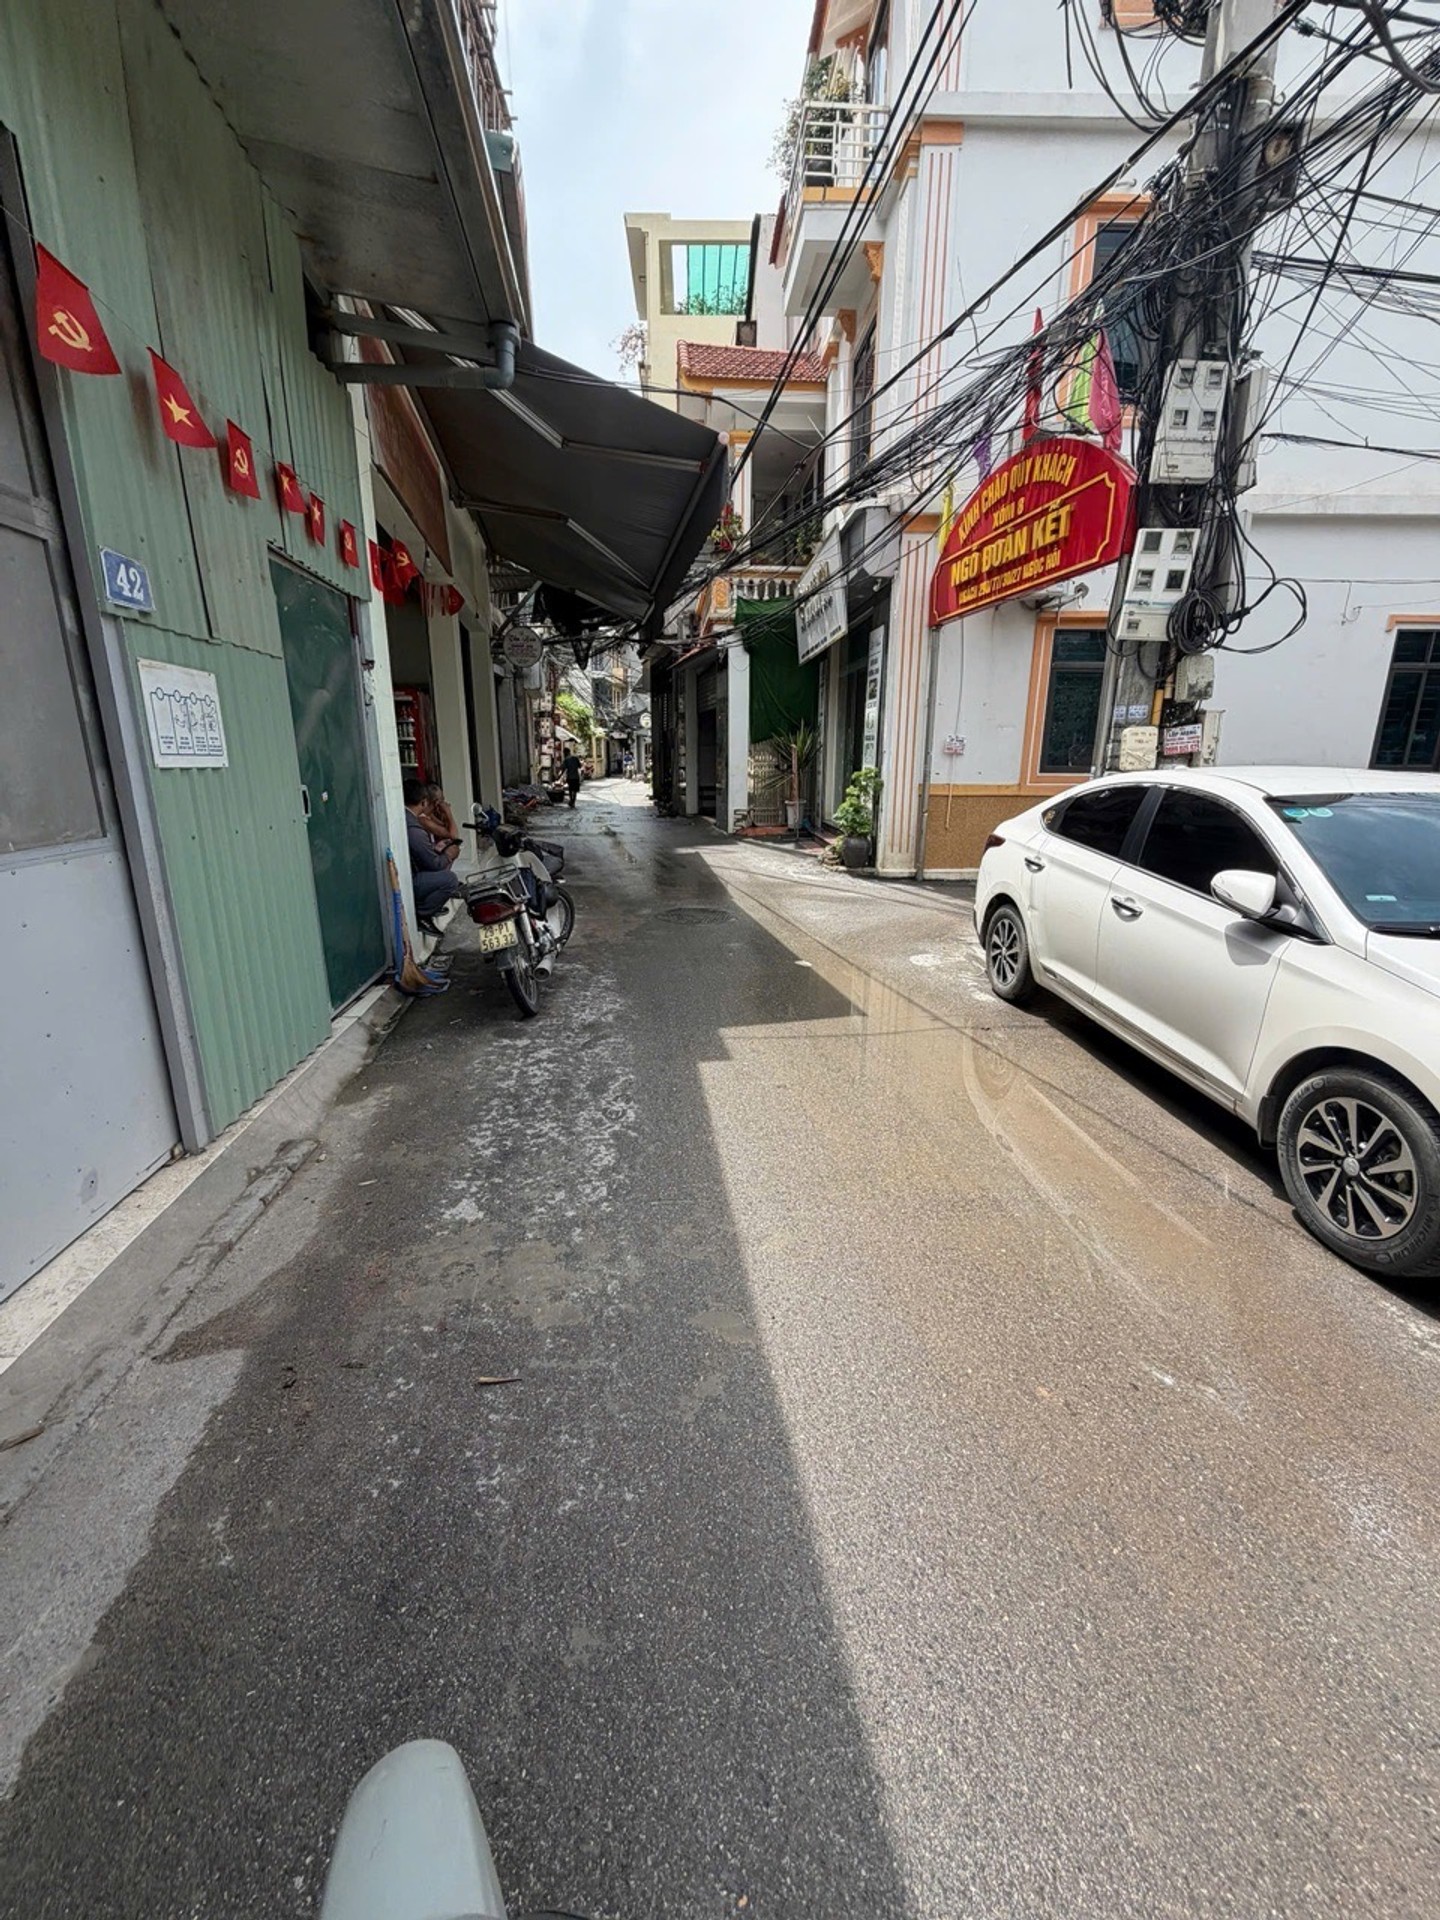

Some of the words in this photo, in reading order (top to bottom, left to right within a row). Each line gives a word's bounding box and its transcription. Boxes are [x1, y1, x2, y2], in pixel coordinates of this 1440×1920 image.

[980, 471, 1009, 514] CHÀO
[1033, 446, 1078, 487] KHÁCH
[951, 545, 980, 587] NGÕ
[982, 527, 1027, 574] ĐOÀN
[1032, 498, 1074, 550] KẾT
[116, 563, 144, 602] 42
[1393, 1213, 1434, 1262] MICHELIN
